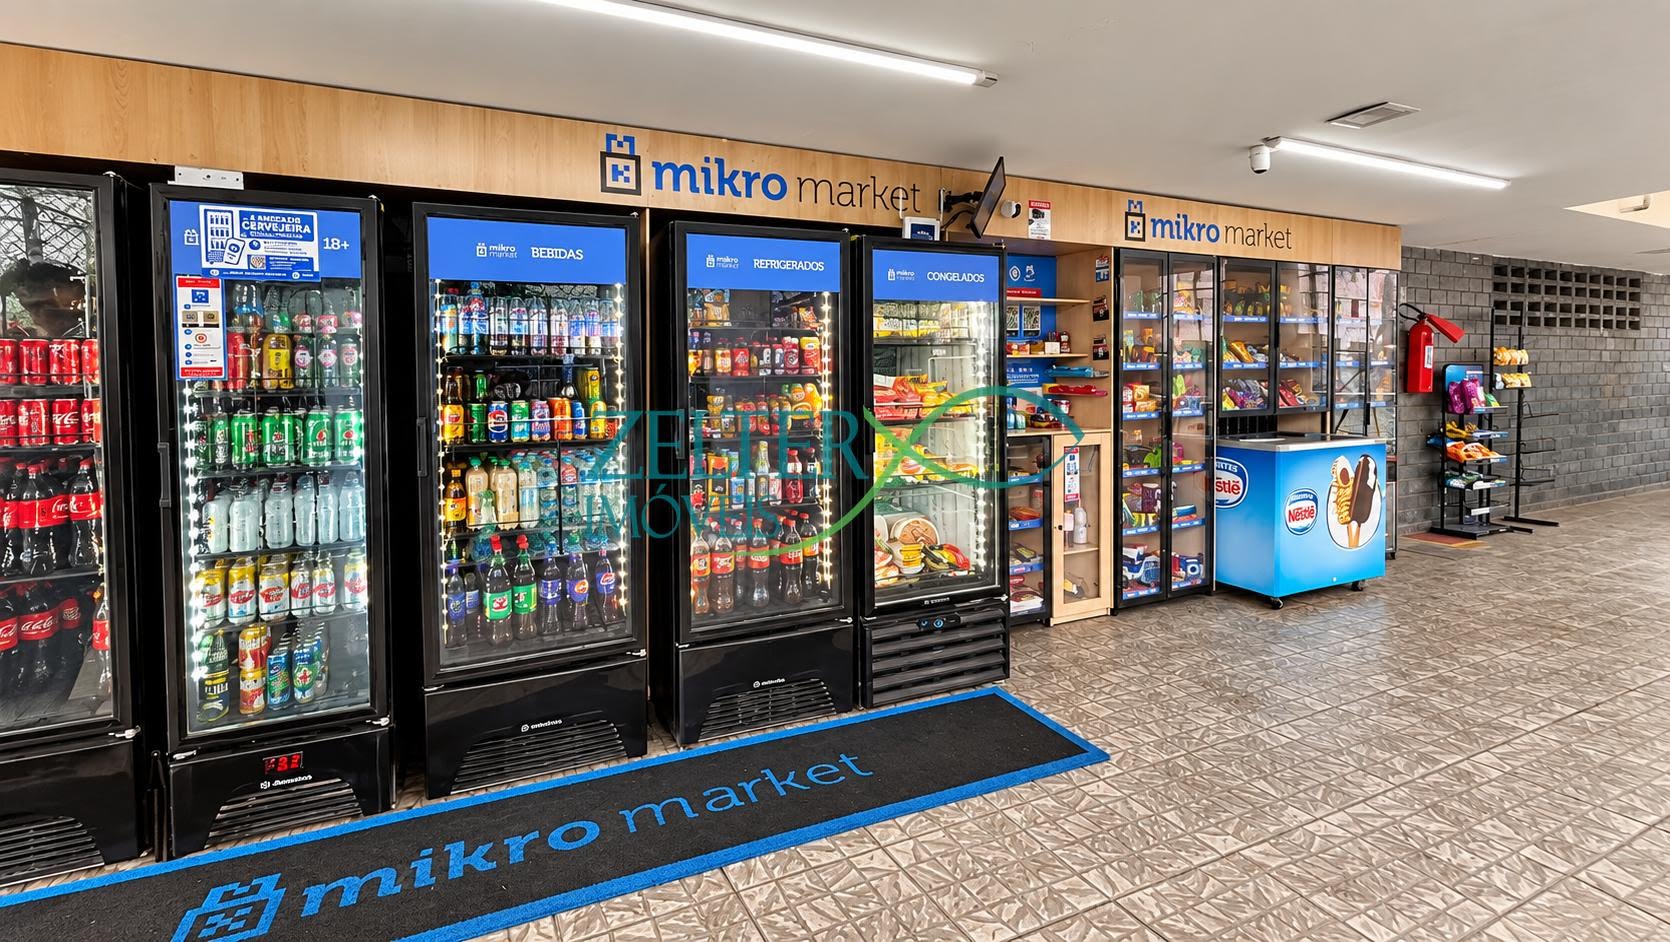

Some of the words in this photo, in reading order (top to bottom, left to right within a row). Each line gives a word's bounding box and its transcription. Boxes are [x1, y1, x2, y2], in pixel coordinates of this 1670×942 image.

[652, 156, 788, 201] mikro
[797, 175, 921, 213] market
[241, 221, 312, 234] CERVEJEIRA
[1150, 213, 1220, 243] mikro
[1224, 223, 1292, 250] market
[323, 237, 350, 250] 18+
[489, 243, 516, 252] mikro
[531, 246, 584, 261] BEBIDAS
[753, 258, 825, 272] REFRIGERADOS
[926, 271, 985, 283] CONGELADOS
[1216, 479, 1241, 495] stlé
[300, 817, 601, 918] mikro
[619, 752, 874, 834] market
